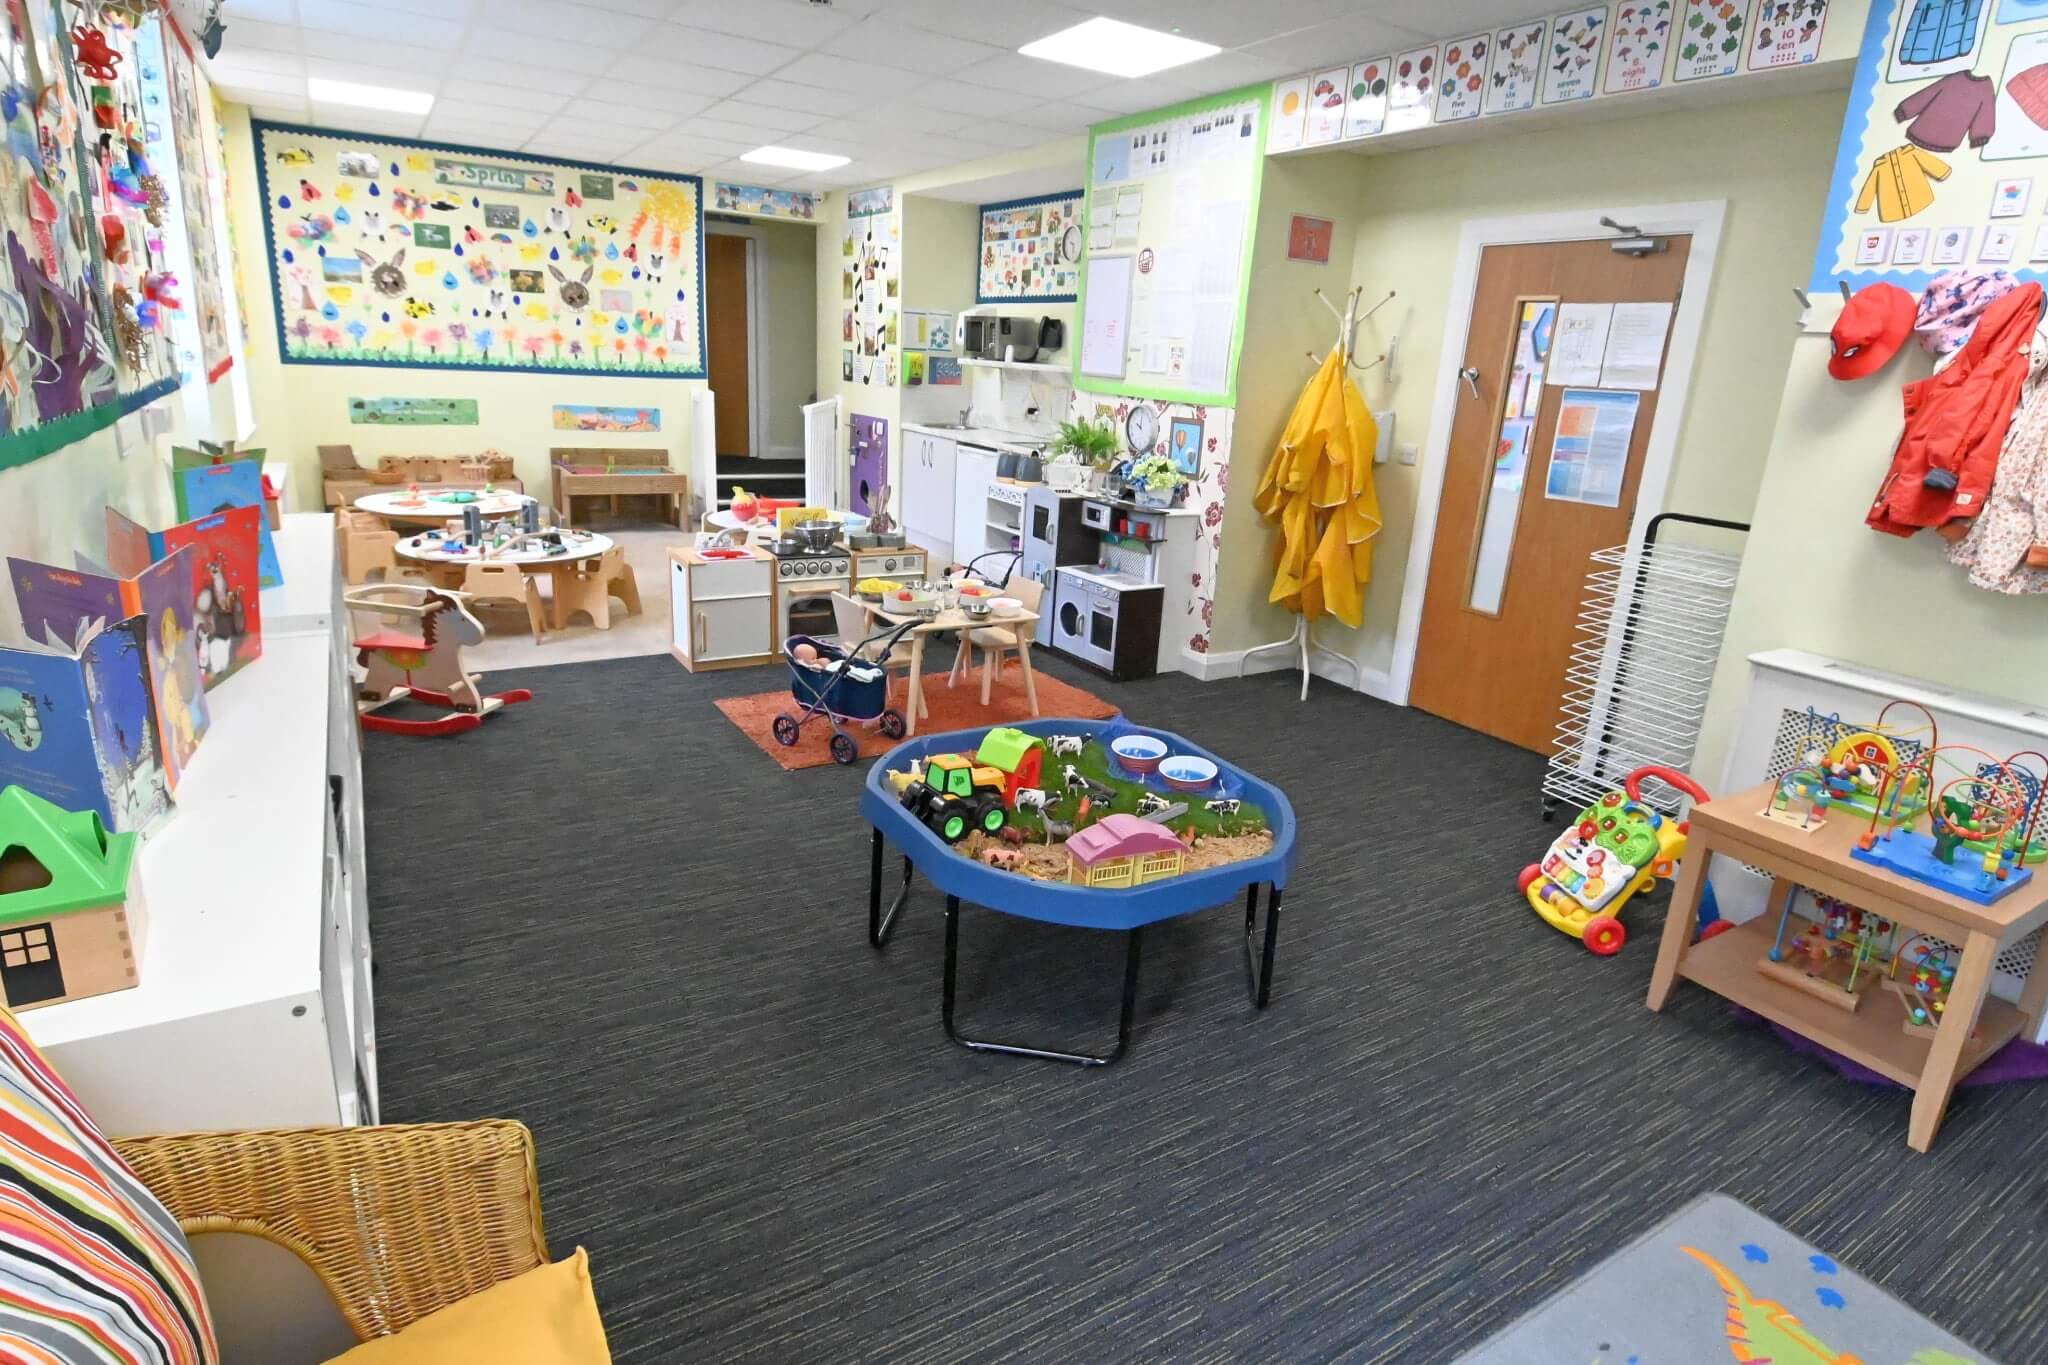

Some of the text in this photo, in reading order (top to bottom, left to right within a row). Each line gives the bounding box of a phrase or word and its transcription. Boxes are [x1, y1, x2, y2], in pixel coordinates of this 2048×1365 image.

[1782, 29, 1795, 40] 10
[1776, 41, 1796, 51] ten
[1696, 53, 1719, 65] nine
[1622, 66, 1646, 78] eight
[1556, 79, 1581, 89] seven
